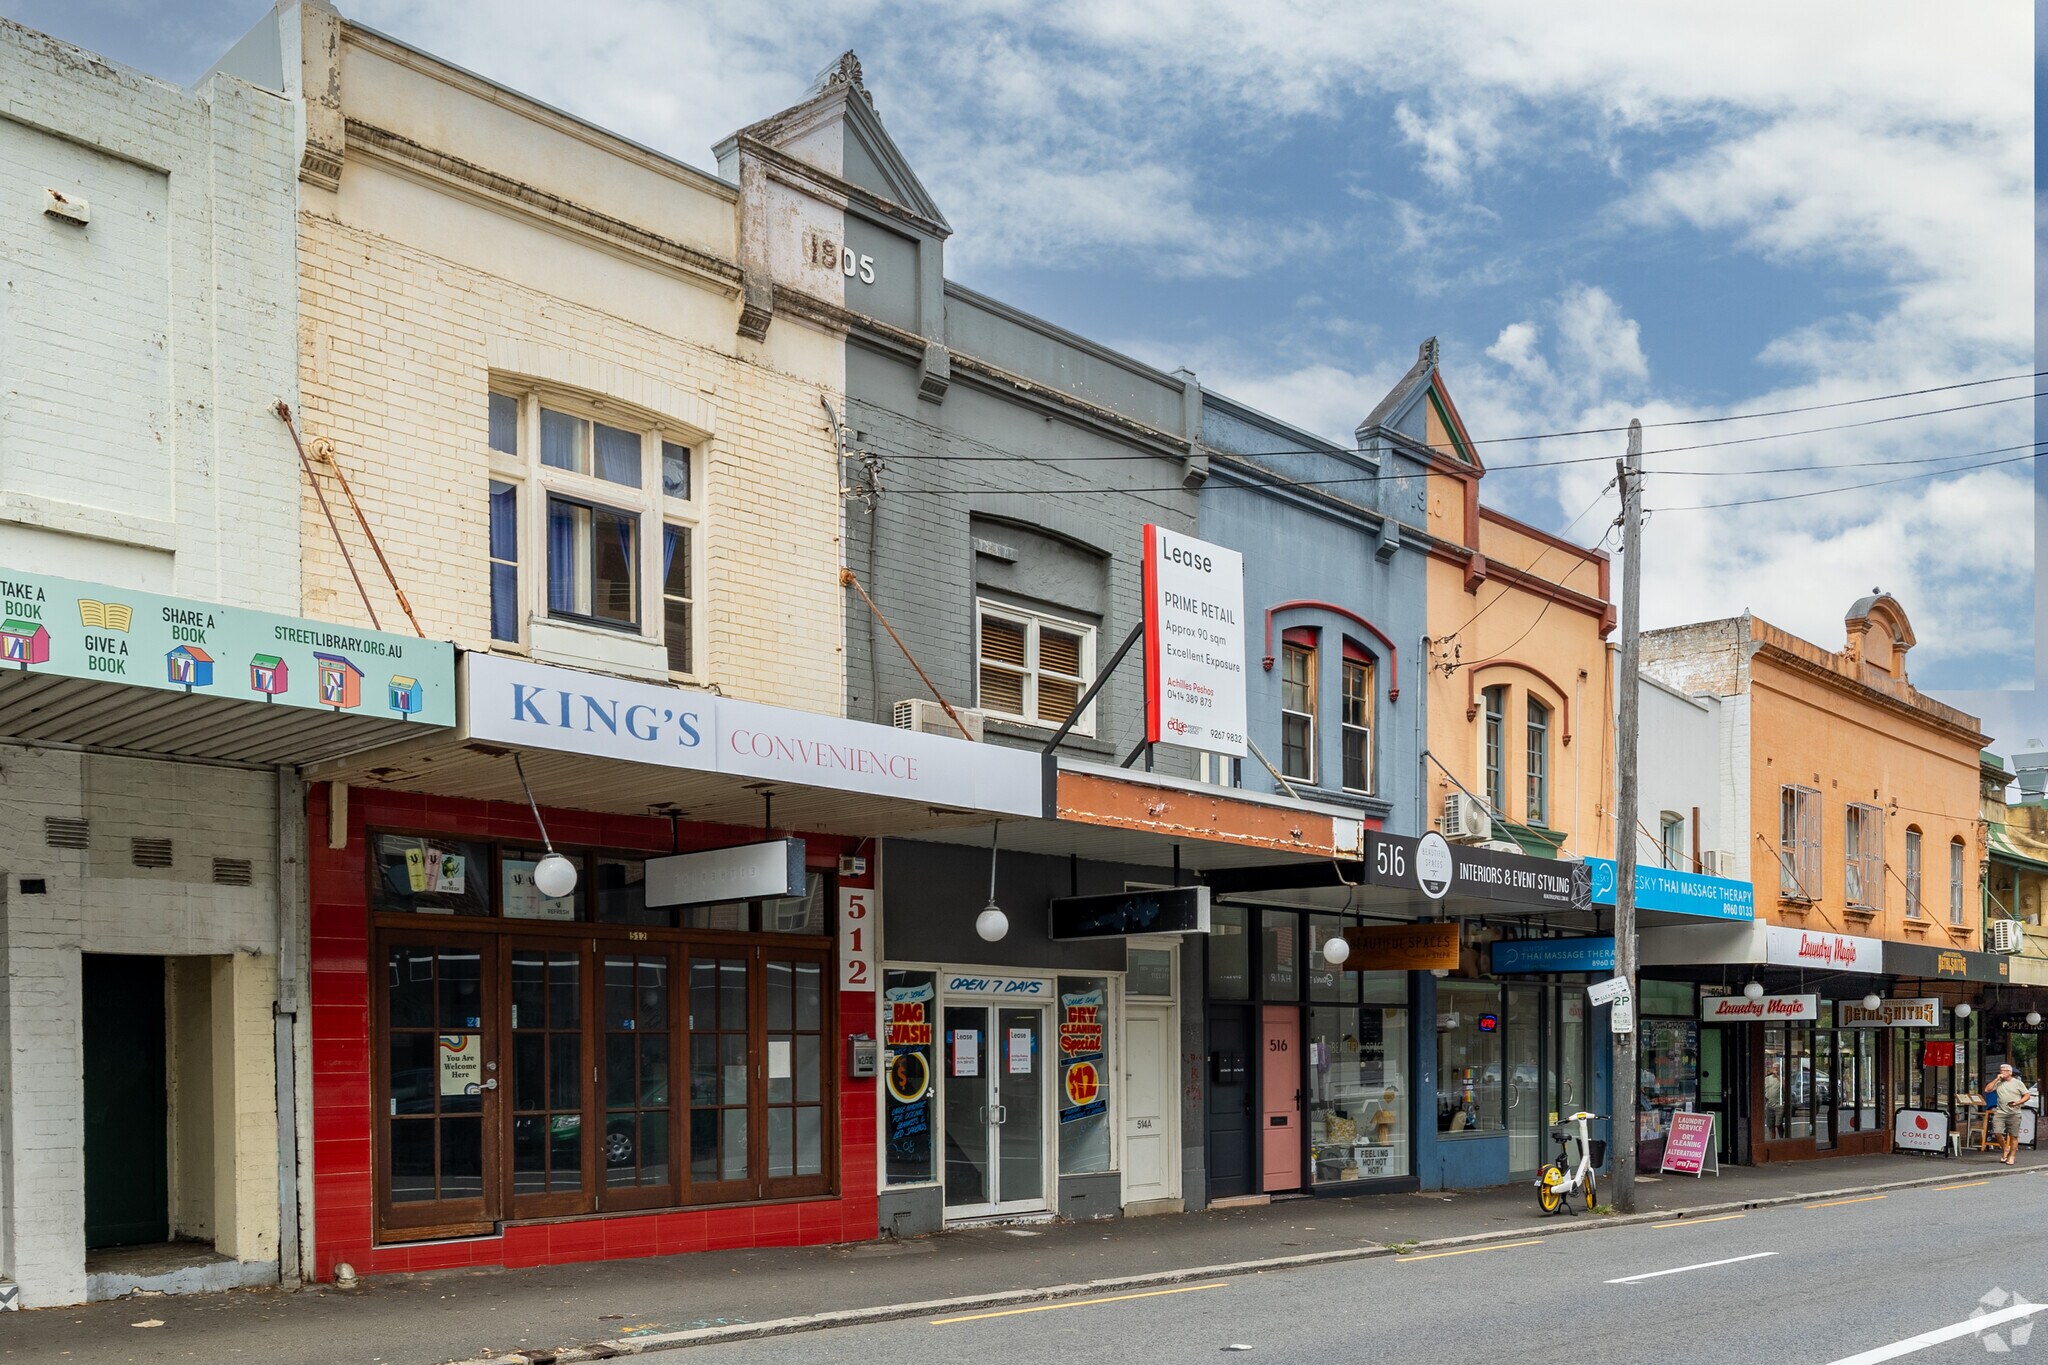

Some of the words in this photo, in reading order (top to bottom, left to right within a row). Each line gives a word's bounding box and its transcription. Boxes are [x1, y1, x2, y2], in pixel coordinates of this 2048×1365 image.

[1163, 537, 1212, 573] Lease
[1, 580, 34, 600] TAKE
[36, 586, 46, 602] A
[5, 601, 42, 620] BOOK
[1165, 591, 1198, 615] PRIME
[1201, 601, 1235, 625] RETAIL
[162, 607, 204, 628] SHARE
[206, 614, 216, 630] A
[171, 625, 207, 645] BOOK
[1165, 620, 1195, 638] Approx
[1197, 627, 1208, 641] 90
[1210, 633, 1227, 646] sqm
[85, 635, 116, 655] GIVE
[119, 641, 129, 656] A
[274, 625, 403, 660] STREETLIBRARY.ORG.AU
[88, 655, 126, 675] BOOK
[1167, 644, 1204, 664] Excellent
[1206, 653, 1241, 673] Exposure
[1167, 677, 1192, 690] Achilles
[1167, 689, 1184, 700] 0414
[1185, 694, 1199, 704] 389
[1200, 697, 1212, 708] 873
[511, 682, 701, 748] KING'S
[731, 728, 918, 781] CONVENIENCE
[1167, 719, 1187, 735] edge
[1210, 729, 1225, 740] 9267
[1226, 732, 1242, 743] 9832
[1377, 842, 1405, 877] 516
[1425, 858, 1443, 869] SPACES
[1460, 862, 1503, 884] INTERIORS
[1504, 869, 1511, 886] &
[1513, 870, 1536, 889] EVENT
[1538, 874, 1570, 893] STYLING
[1658, 878, 1679, 894] THAI
[1681, 882, 1717, 899] MASSAGE
[1719, 887, 1752, 903] THERAPY
[1723, 903, 1737, 915] 8960
[1738, 905, 1753, 917] 0133
[1408, 935, 1450, 949] SPACES
[1798, 932, 1833, 966] Laundry
[1834, 937, 1857, 968] Magic
[1521, 952, 1542, 960] THAI
[1544, 951, 1584, 960] MASSAGE
[1587, 949, 1616, 958] THERA
[950, 978, 990, 992] OPEN
[993, 980, 1003, 993] 7
[1004, 980, 1043, 994] DAYS
[1614, 996, 1630, 1006] 2P
[1715, 1000, 1764, 1017] Laundry
[1766, 999, 1804, 1016] Magic
[893, 1002, 924, 1023] BAG
[1067, 1006, 1098, 1023] DRY
[887, 1023, 931, 1045] WASH
[1011, 1031, 1027, 1039] Lease
[1060, 1024, 1102, 1034] CLEANING
[1060, 1035, 1101, 1057] Special
[1270, 1039, 1288, 1051] 516
[1137, 1120, 1152, 1129] 514A
[1677, 1117, 1706, 1125] LAUNDRY
[1672, 1140, 1701, 1148] CLEANING
[1901, 1131, 1941, 1140] COMECO
[1361, 1149, 1388, 1158] FEELING
[1667, 1148, 1702, 1158] ALTERATIONS
[1375, 1158, 1387, 1166] HOT
[1685, 1160, 1691, 1168] 7
